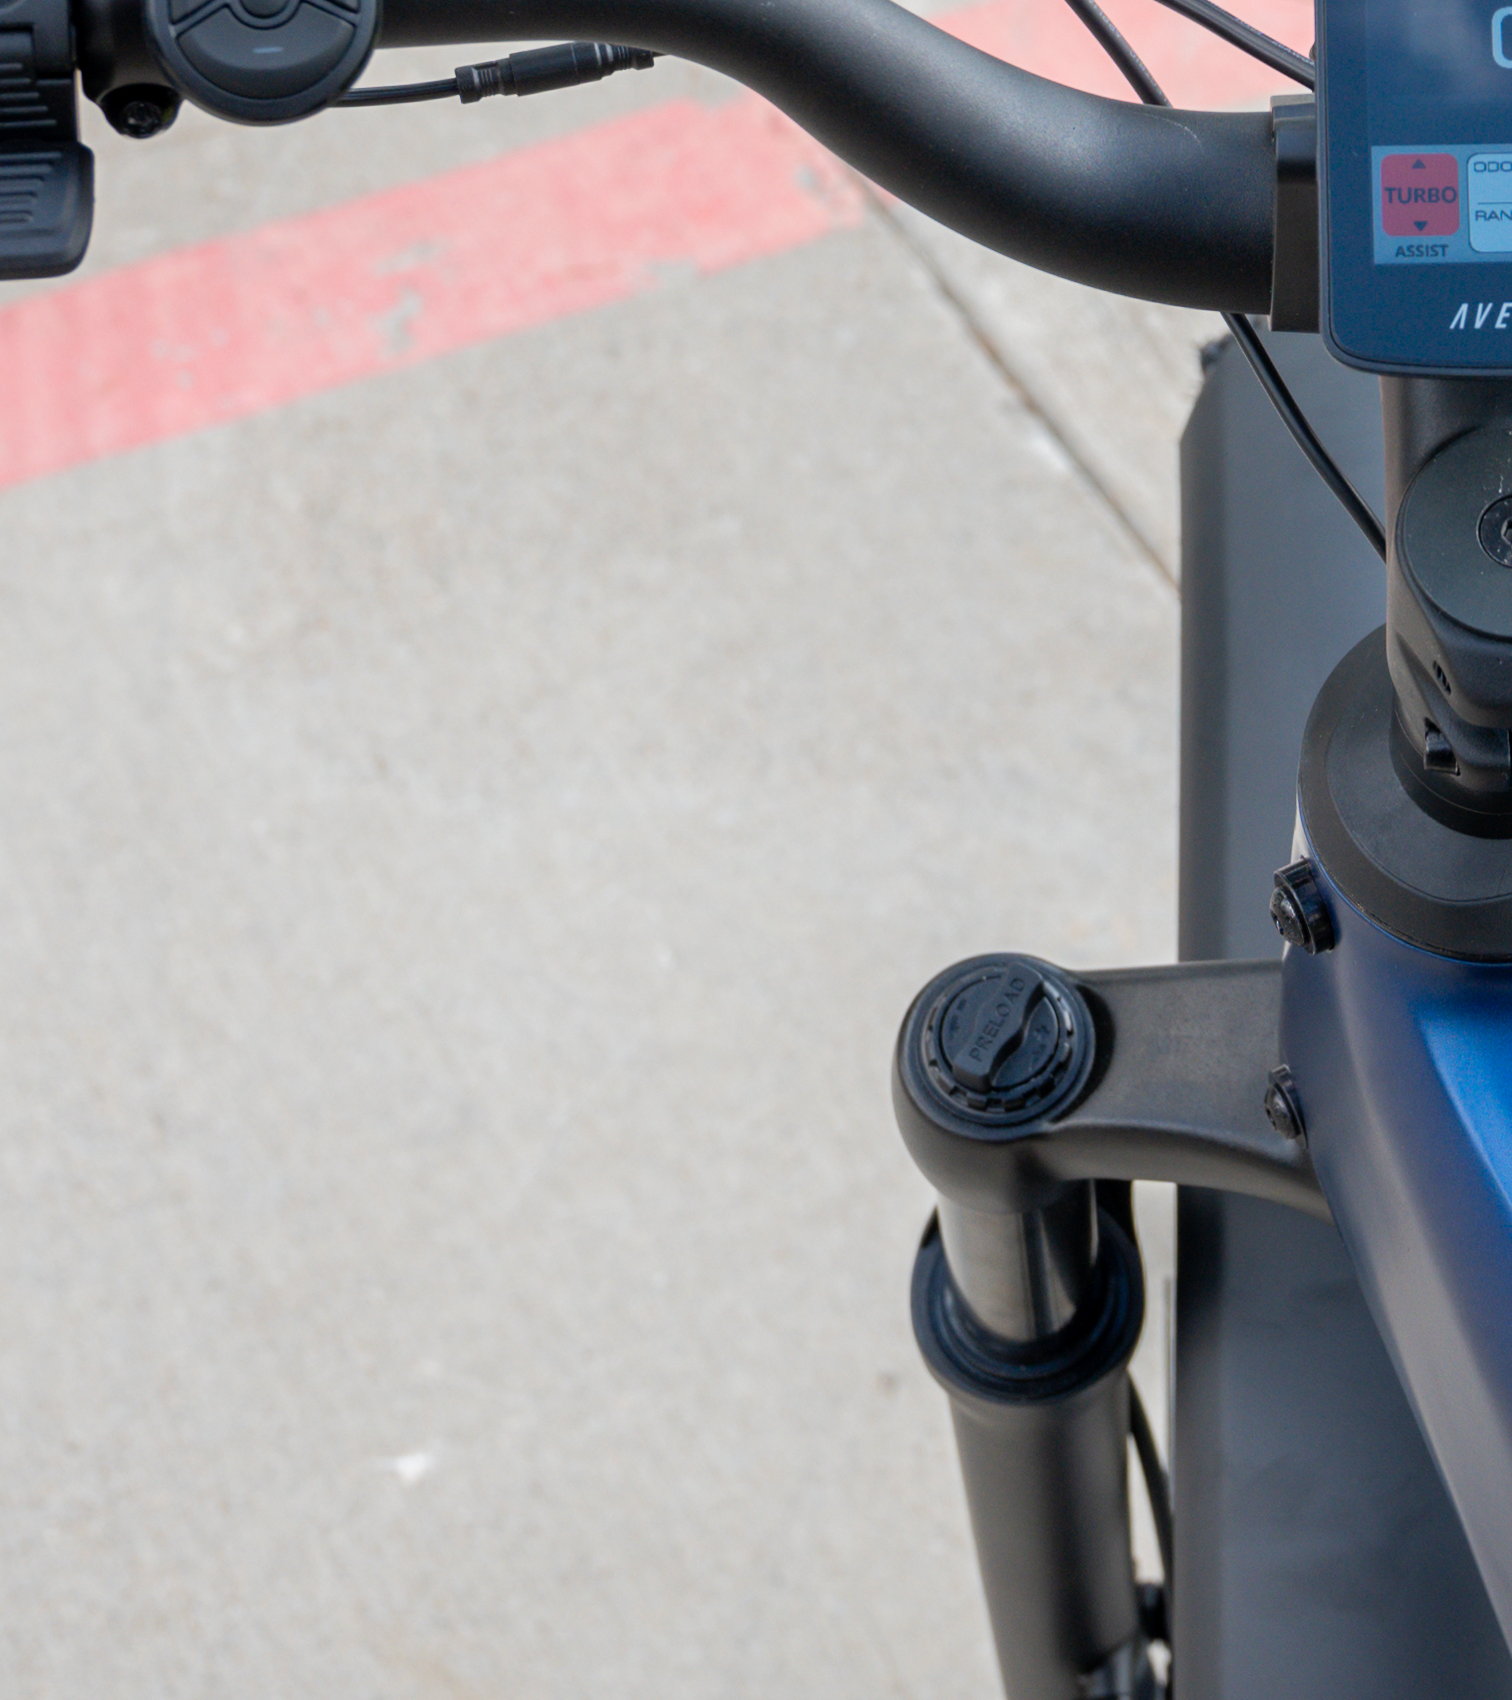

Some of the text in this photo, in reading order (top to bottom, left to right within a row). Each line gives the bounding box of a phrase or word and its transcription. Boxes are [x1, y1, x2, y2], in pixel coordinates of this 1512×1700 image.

[1384, 186, 1458, 204] TURBO
[1395, 243, 1449, 258] ASSIST
[970, 977, 1025, 1063] PRELOAD
